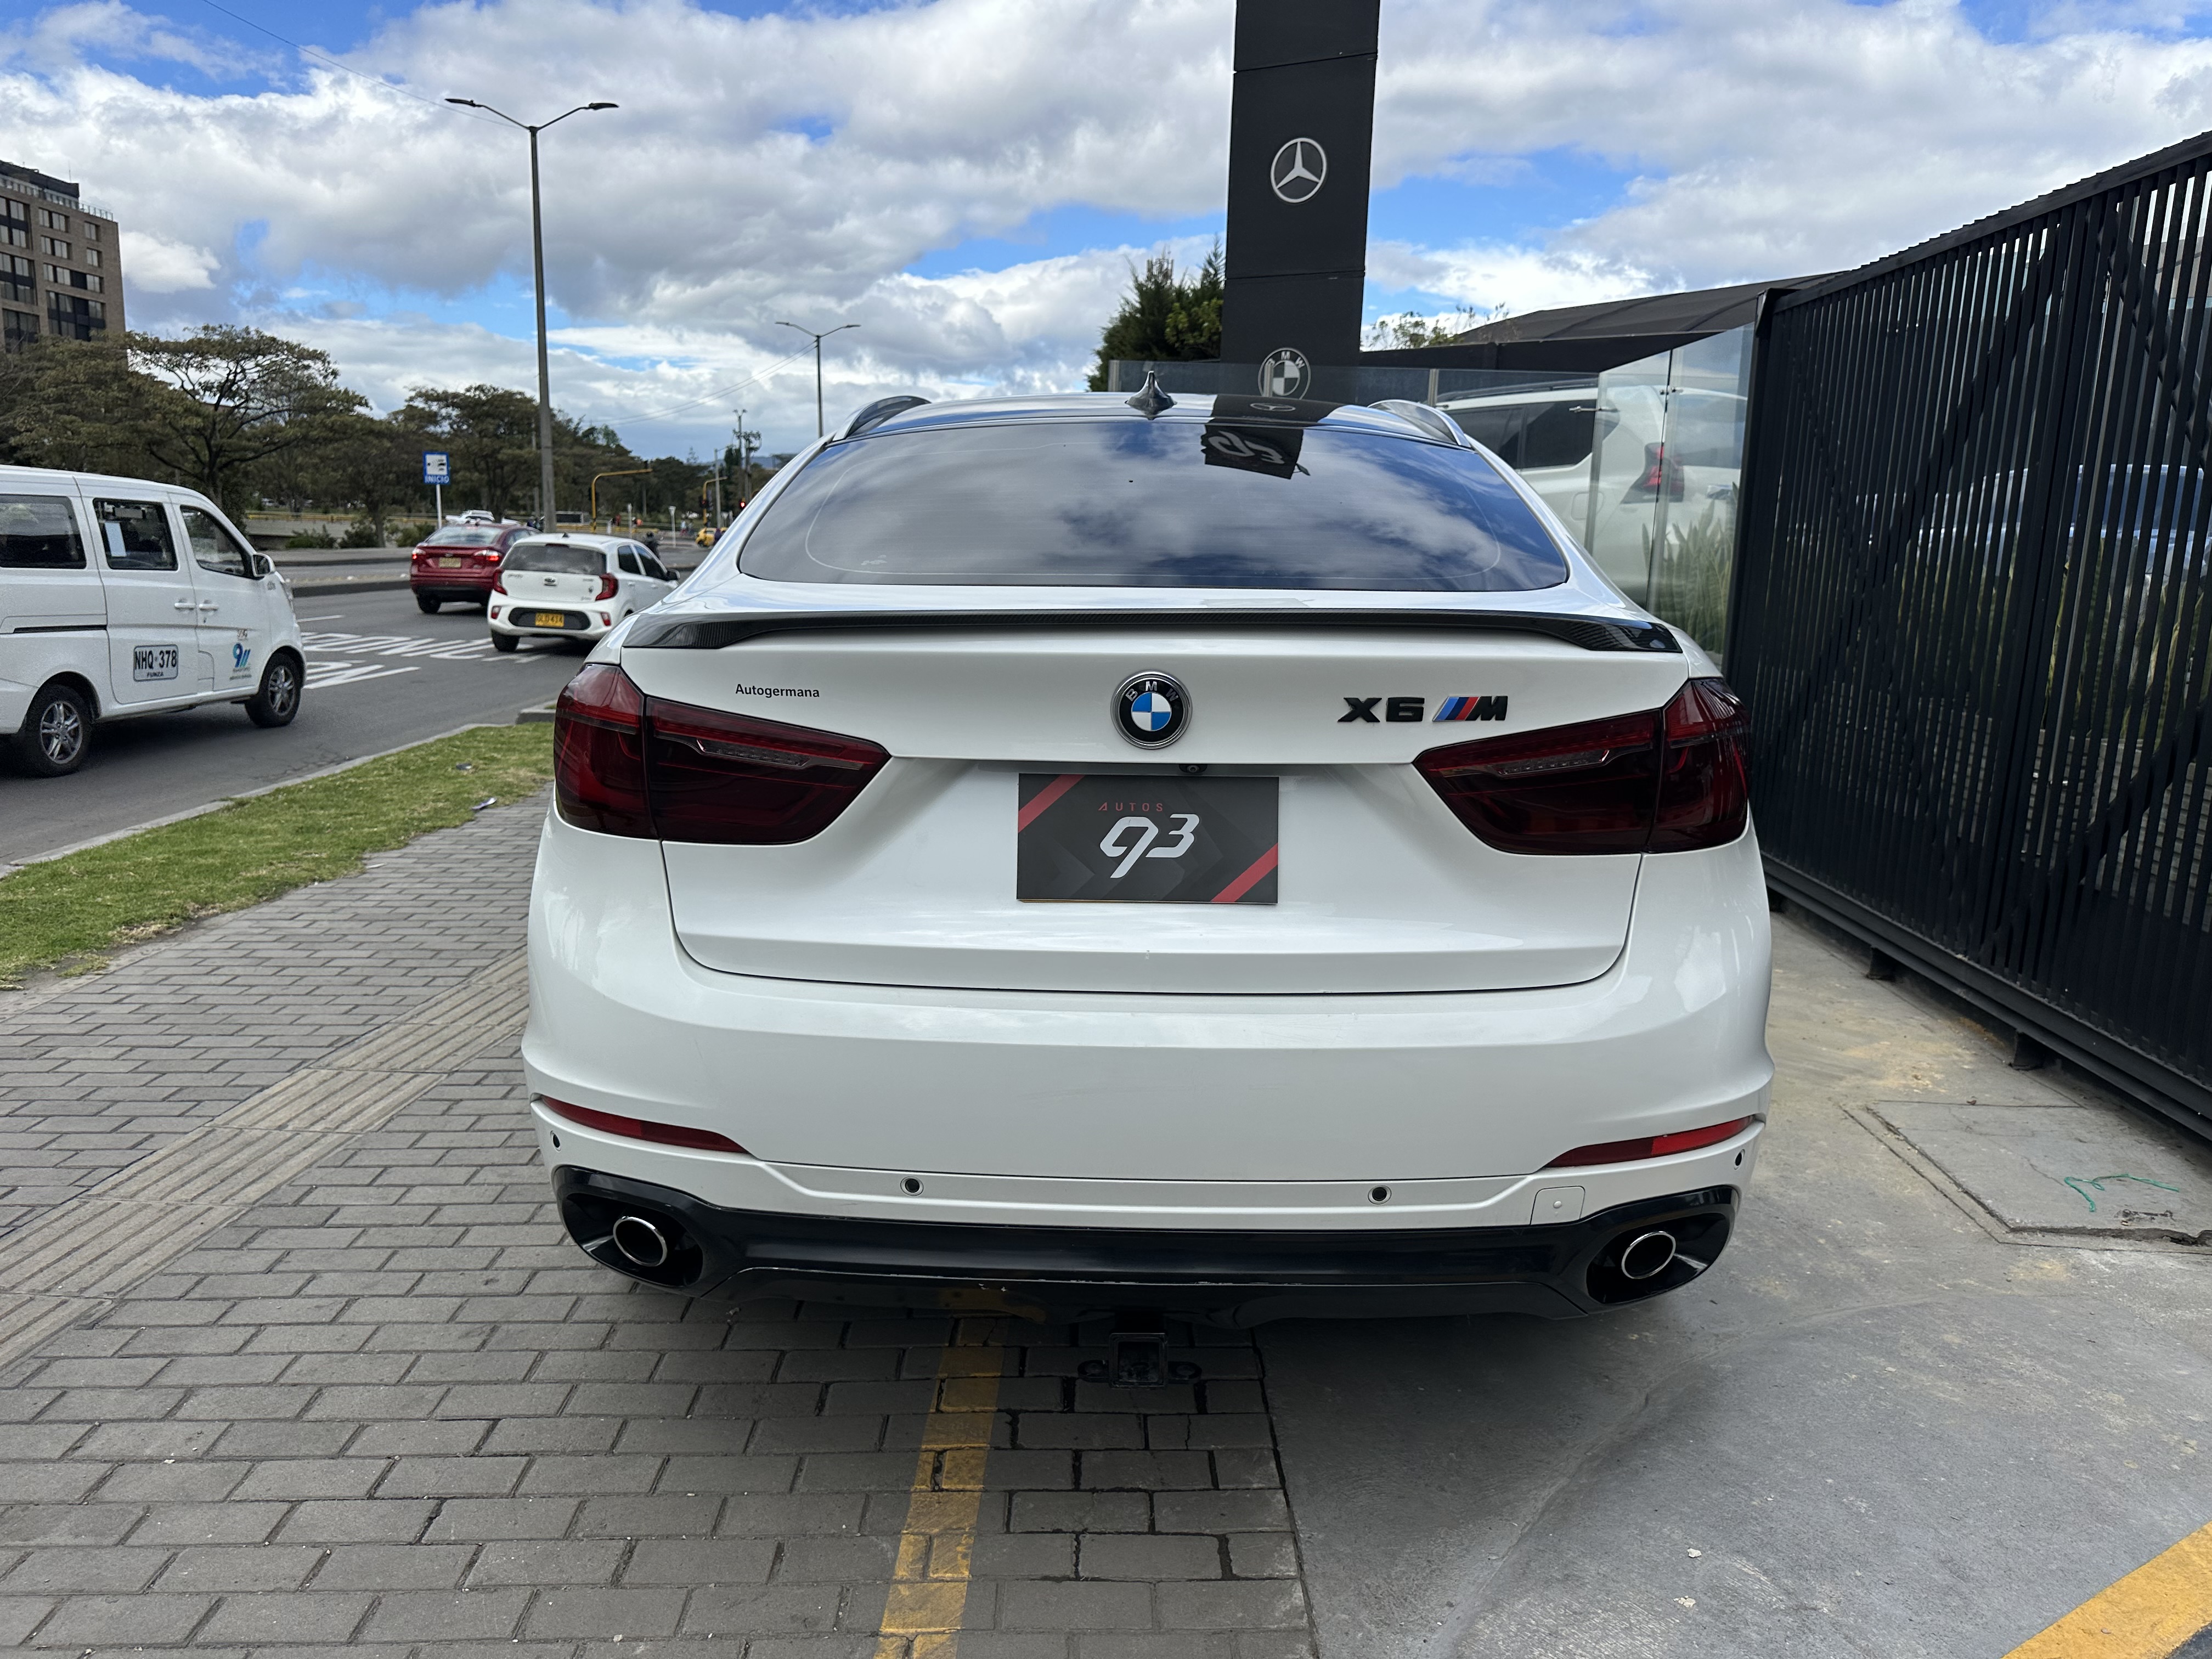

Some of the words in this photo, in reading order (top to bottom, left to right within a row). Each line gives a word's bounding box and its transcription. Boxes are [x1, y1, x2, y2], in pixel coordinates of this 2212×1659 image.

[425, 475, 450, 483] INICIO
[736, 684, 820, 698] Autogermana
[1125, 681, 1179, 702] BMW
[1338, 697, 1425, 722] X6
[1098, 802, 1163, 812] AUTOS
[1100, 814, 1200, 878] 93
